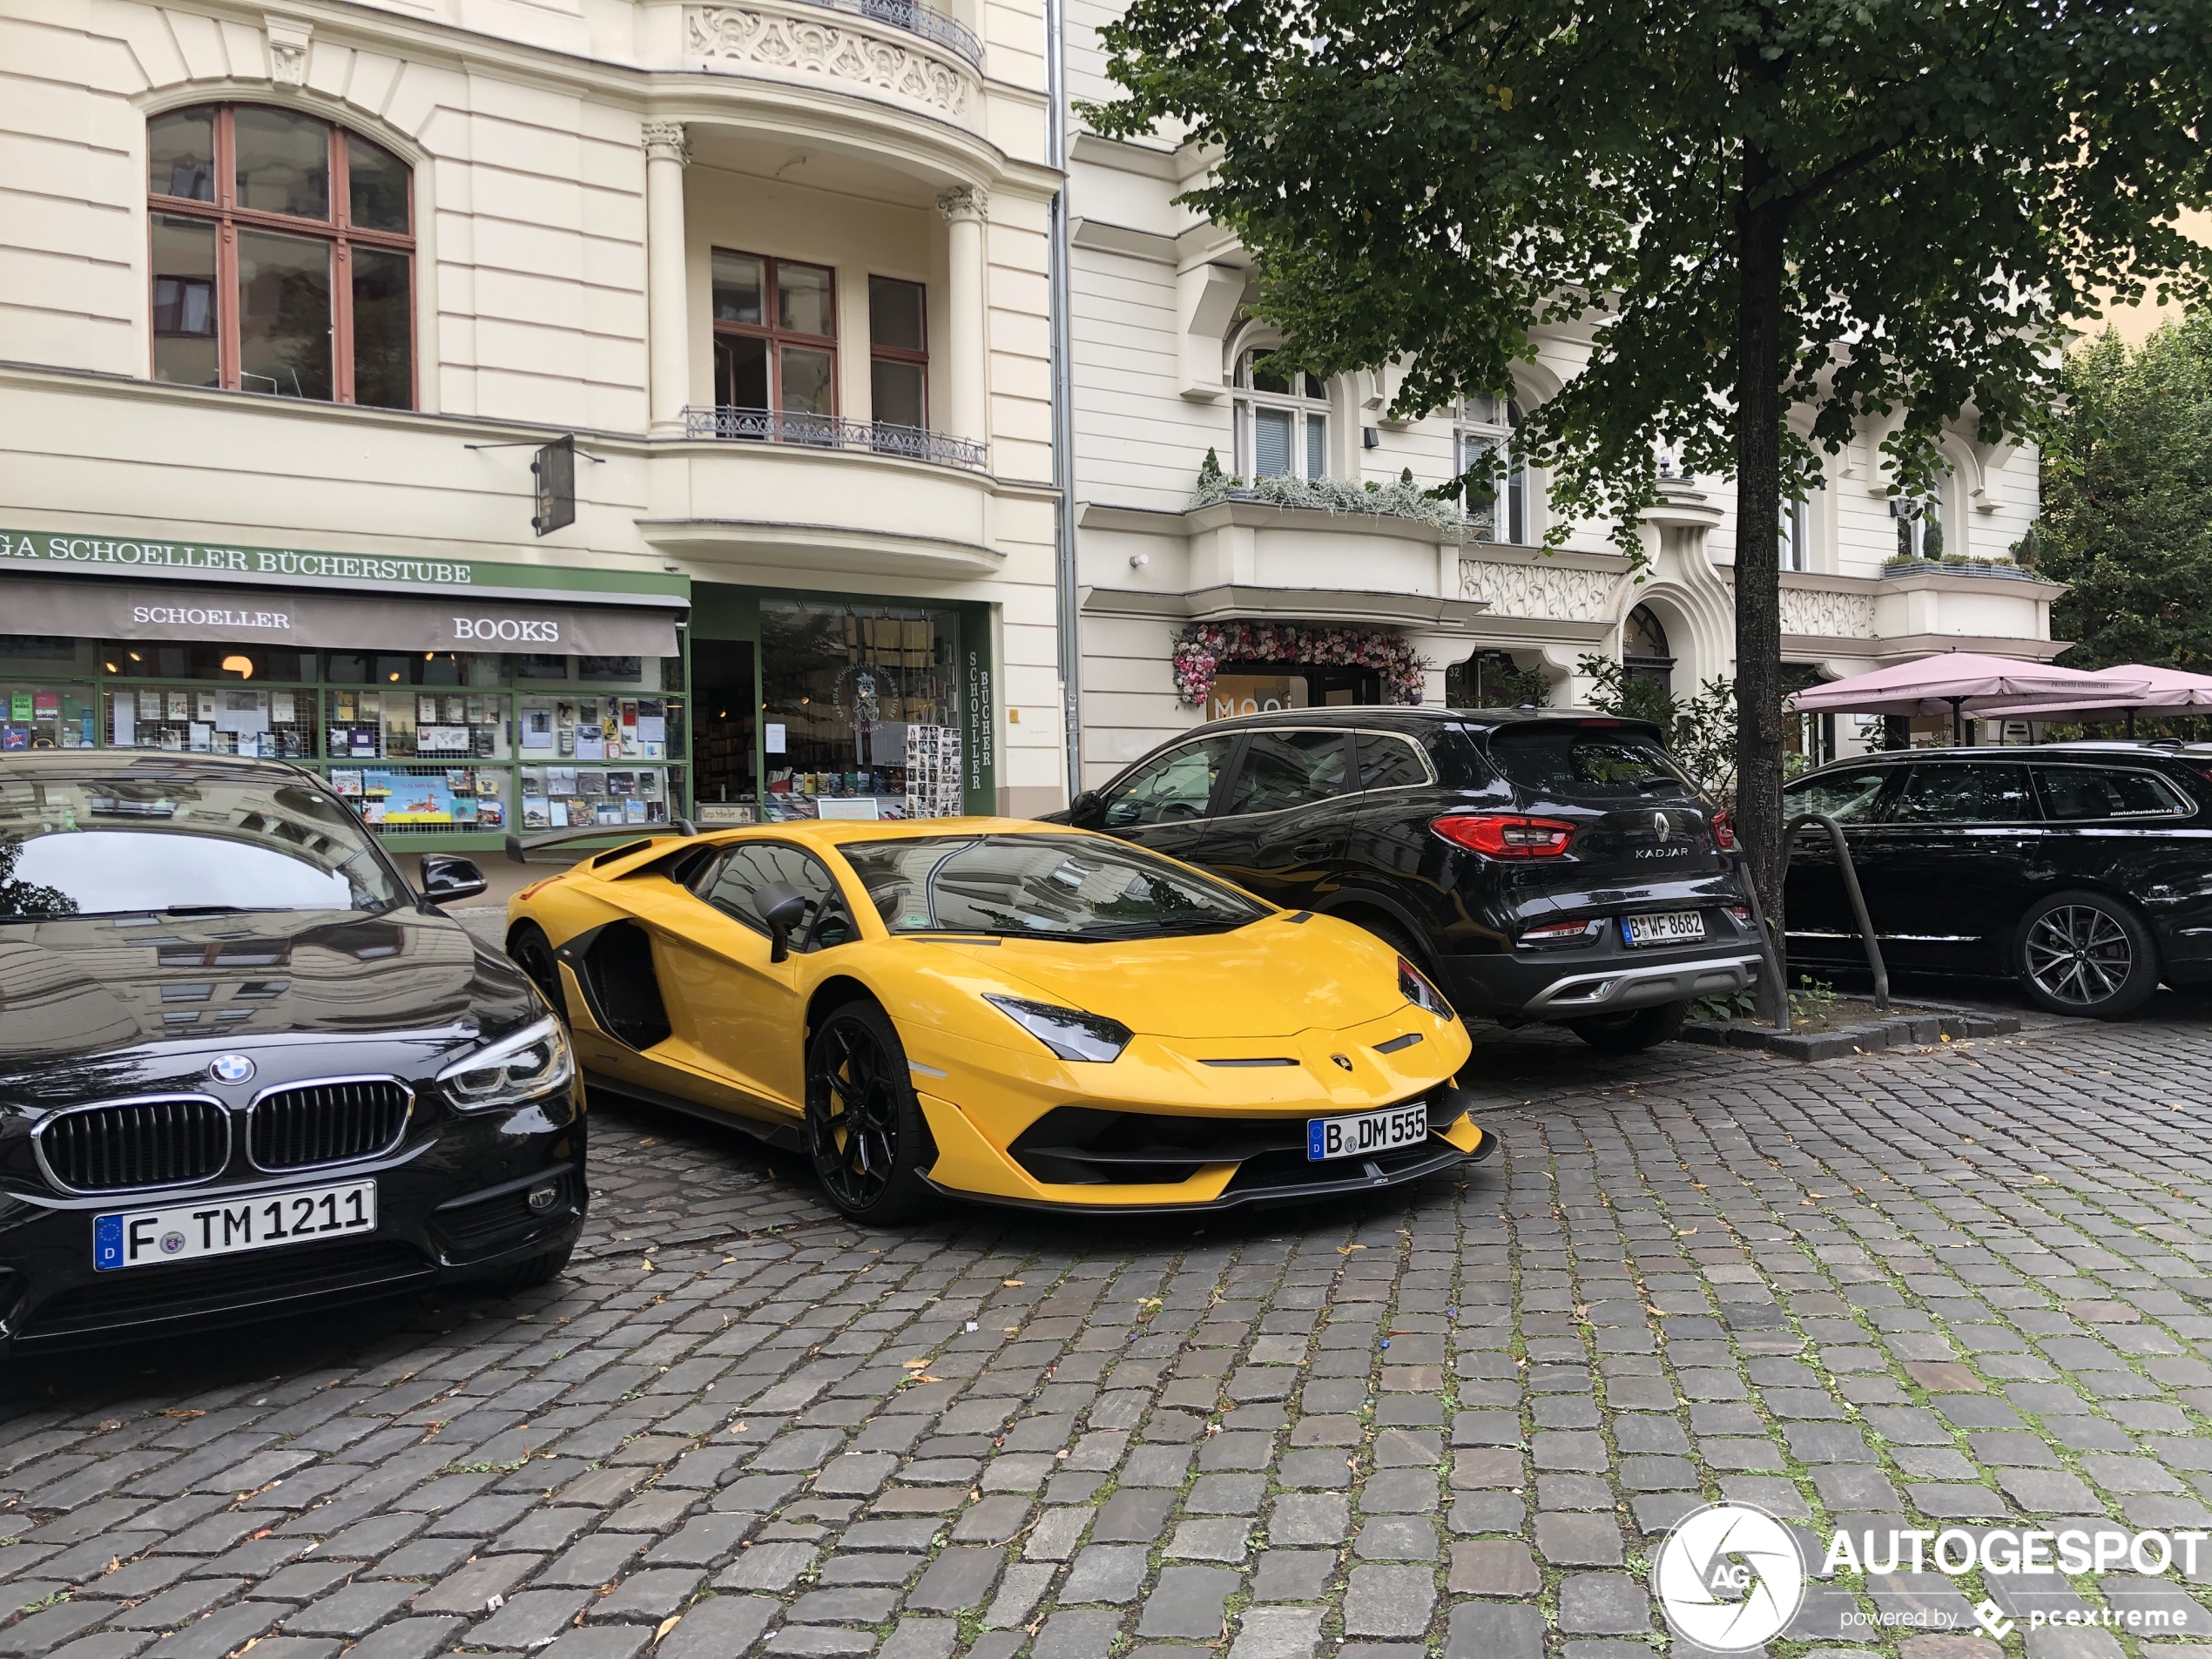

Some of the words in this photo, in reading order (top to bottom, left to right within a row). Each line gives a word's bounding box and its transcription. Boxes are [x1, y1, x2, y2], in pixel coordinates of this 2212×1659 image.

[49, 538, 248, 570] SCHOELLER
[257, 551, 471, 583] BÜCHERSTUBE
[133, 606, 290, 629] SCHOELLER
[453, 617, 559, 642] BOOKS
[836, 662, 873, 685] SCHOELLER
[1449, 667, 1460, 678] 32
[848, 721, 859, 731] 90
[860, 724, 884, 733] JAHRE
[969, 651, 981, 789] SCHOELLER
[981, 671, 991, 766] BÜCHER
[1635, 847, 1689, 859] KADJAR
[1629, 918, 1642, 938] B
[1648, 915, 1666, 936] WF
[1669, 914, 1703, 934] 8682
[1313, 1143, 1320, 1153] D
[1326, 1123, 1342, 1154] B
[1359, 1116, 1387, 1149] DM
[1392, 1109, 1426, 1143] 555
[105, 1247, 115, 1259] D
[129, 1217, 158, 1259] F
[192, 1205, 252, 1249] TM
[263, 1189, 369, 1240] 1211
